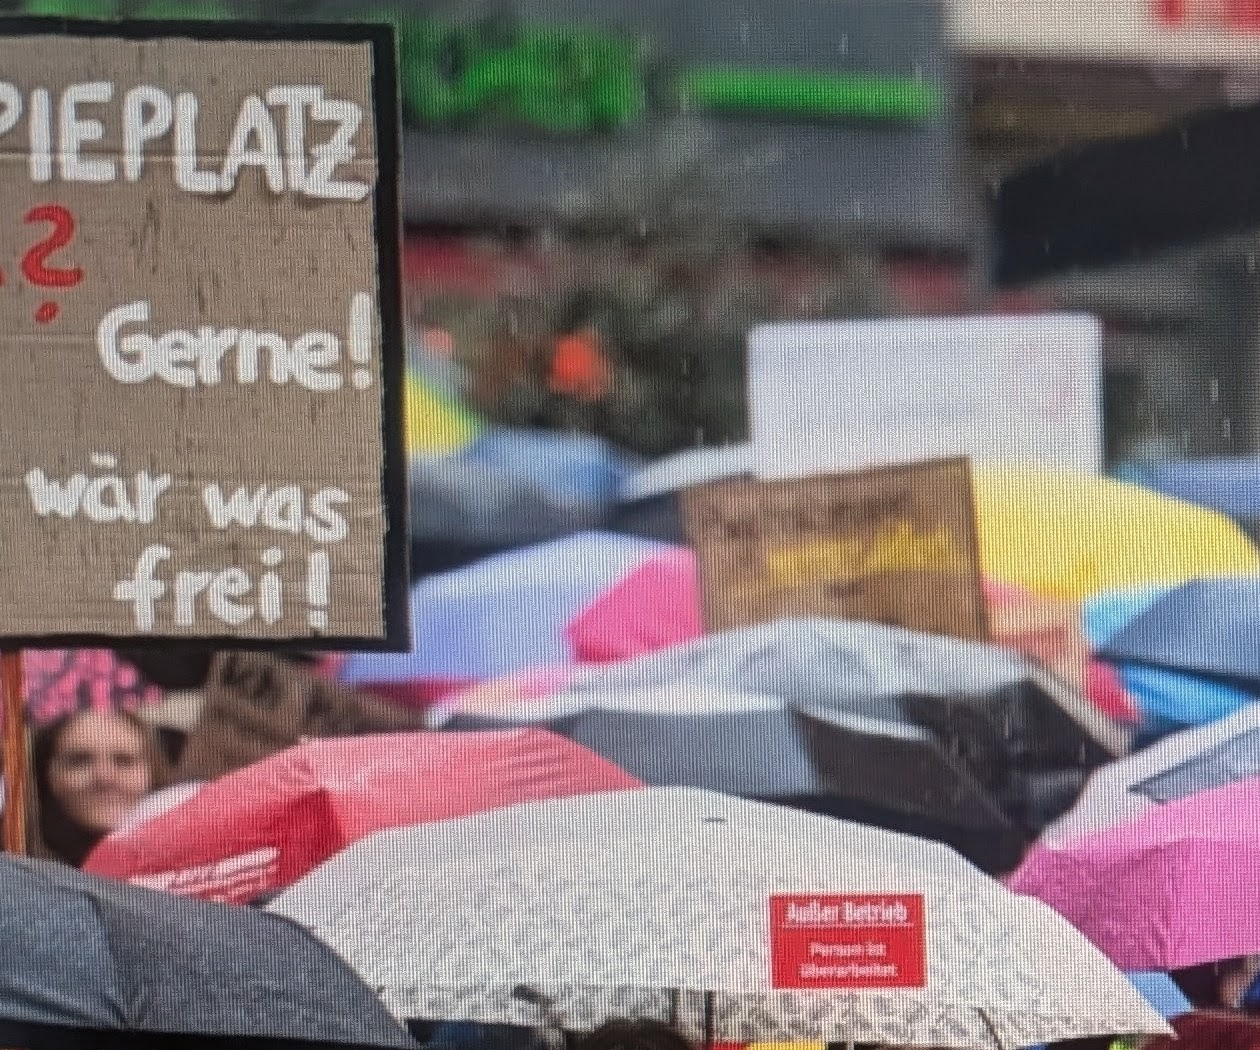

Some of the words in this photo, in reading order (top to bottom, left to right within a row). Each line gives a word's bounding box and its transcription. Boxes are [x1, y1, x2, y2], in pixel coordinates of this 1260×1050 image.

[98, 292, 373, 390] Gerne!
[26, 453, 170, 523] wär
[202, 482, 349, 542] was
[113, 544, 330, 631] frei!
[845, 900, 908, 924] Betrieb
